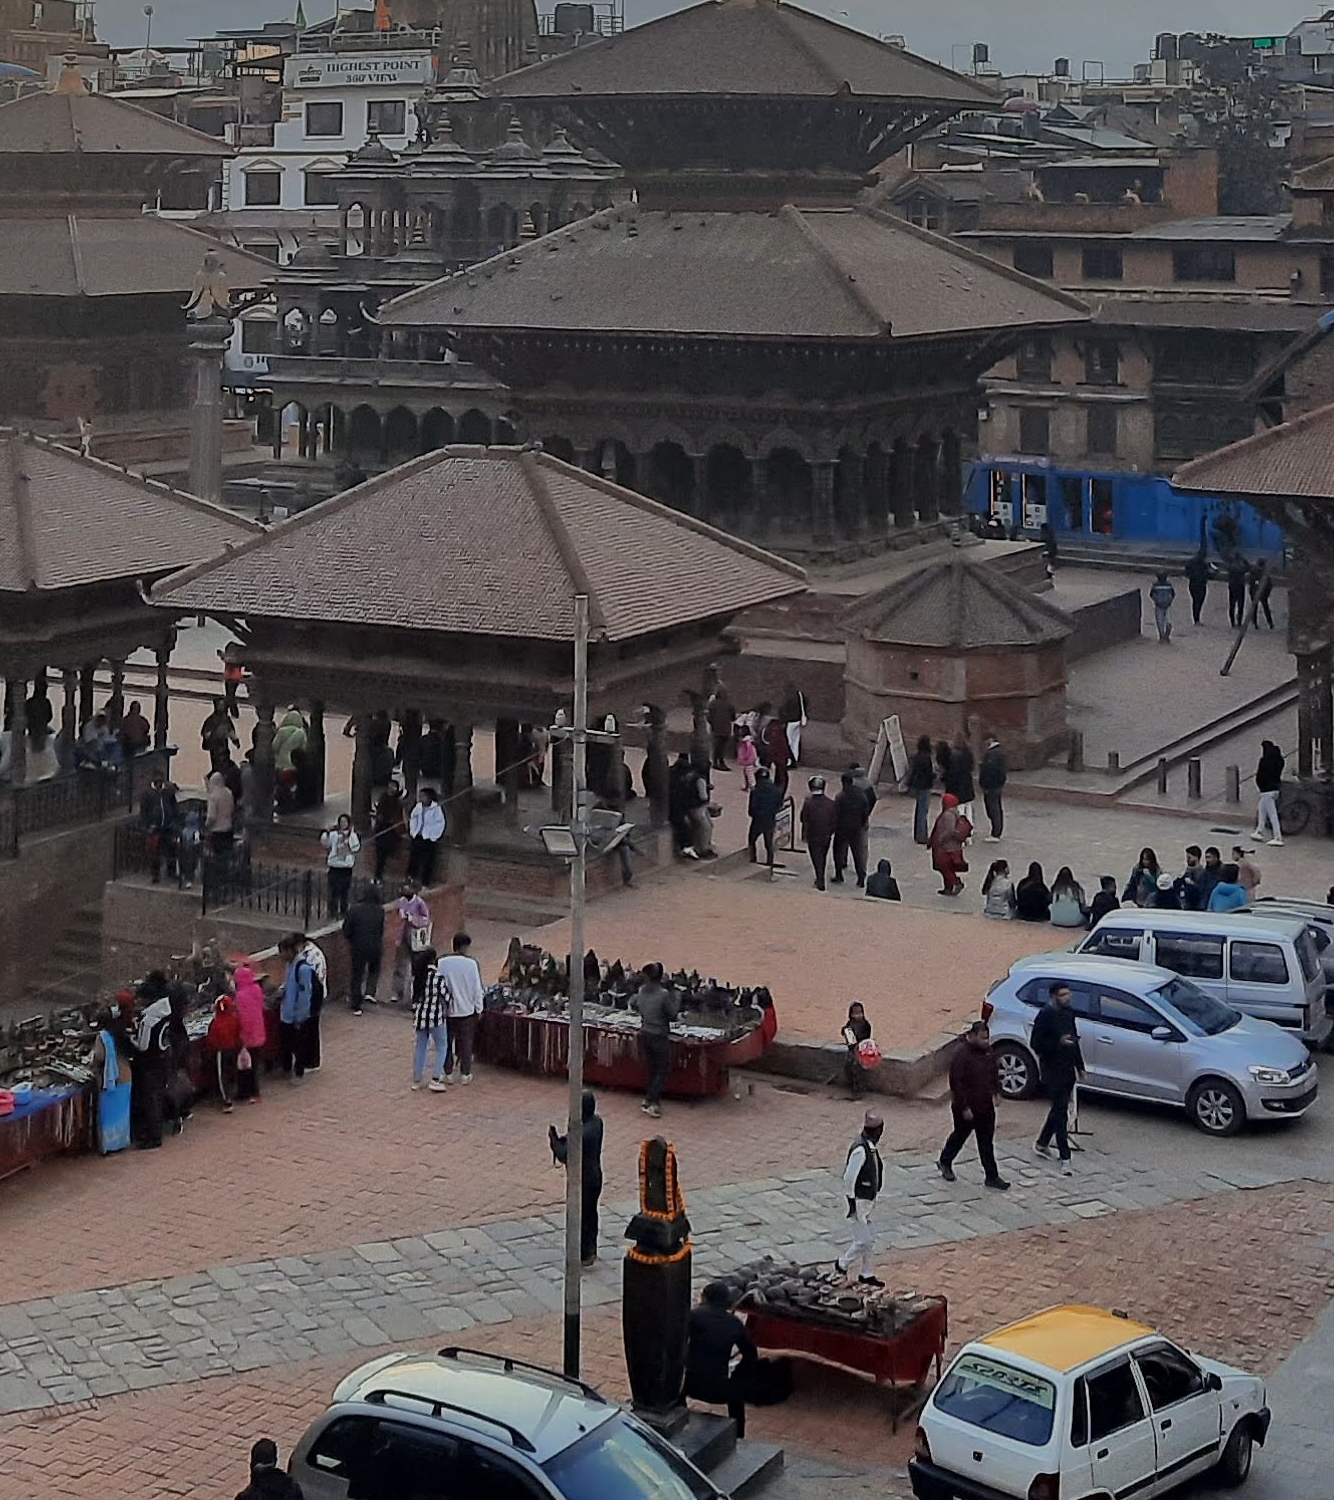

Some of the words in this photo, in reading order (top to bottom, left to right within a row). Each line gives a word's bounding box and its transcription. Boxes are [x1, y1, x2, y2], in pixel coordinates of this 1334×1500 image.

[327, 62, 380, 72] HIGHEST
[383, 60, 421, 71] POINT
[367, 73, 398, 83] VIEW
